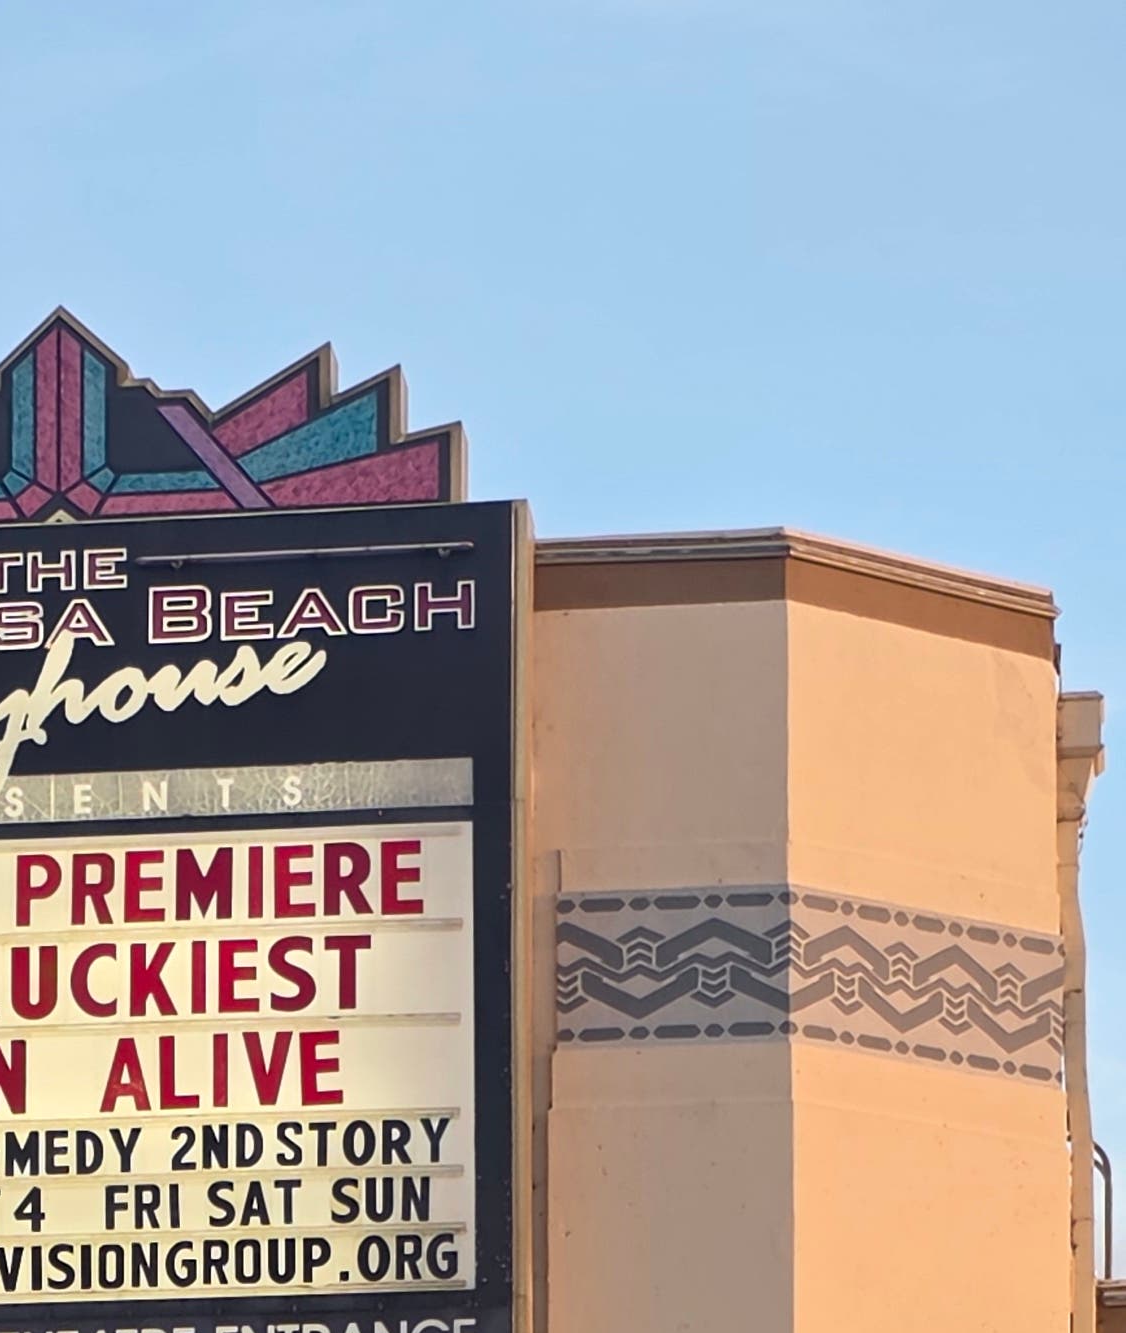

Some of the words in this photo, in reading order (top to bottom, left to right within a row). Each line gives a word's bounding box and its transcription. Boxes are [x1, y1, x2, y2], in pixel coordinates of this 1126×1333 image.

[147, 579, 476, 644] BEACH
[15, 840, 424, 927] PREMIERE
[100, 1030, 344, 1112] ALIVE
[13, 1186, 46, 1233] 4
[104, 1182, 182, 1230] FRI
[207, 1179, 306, 1227] SAT
[330, 1176, 430, 1223] SUN
